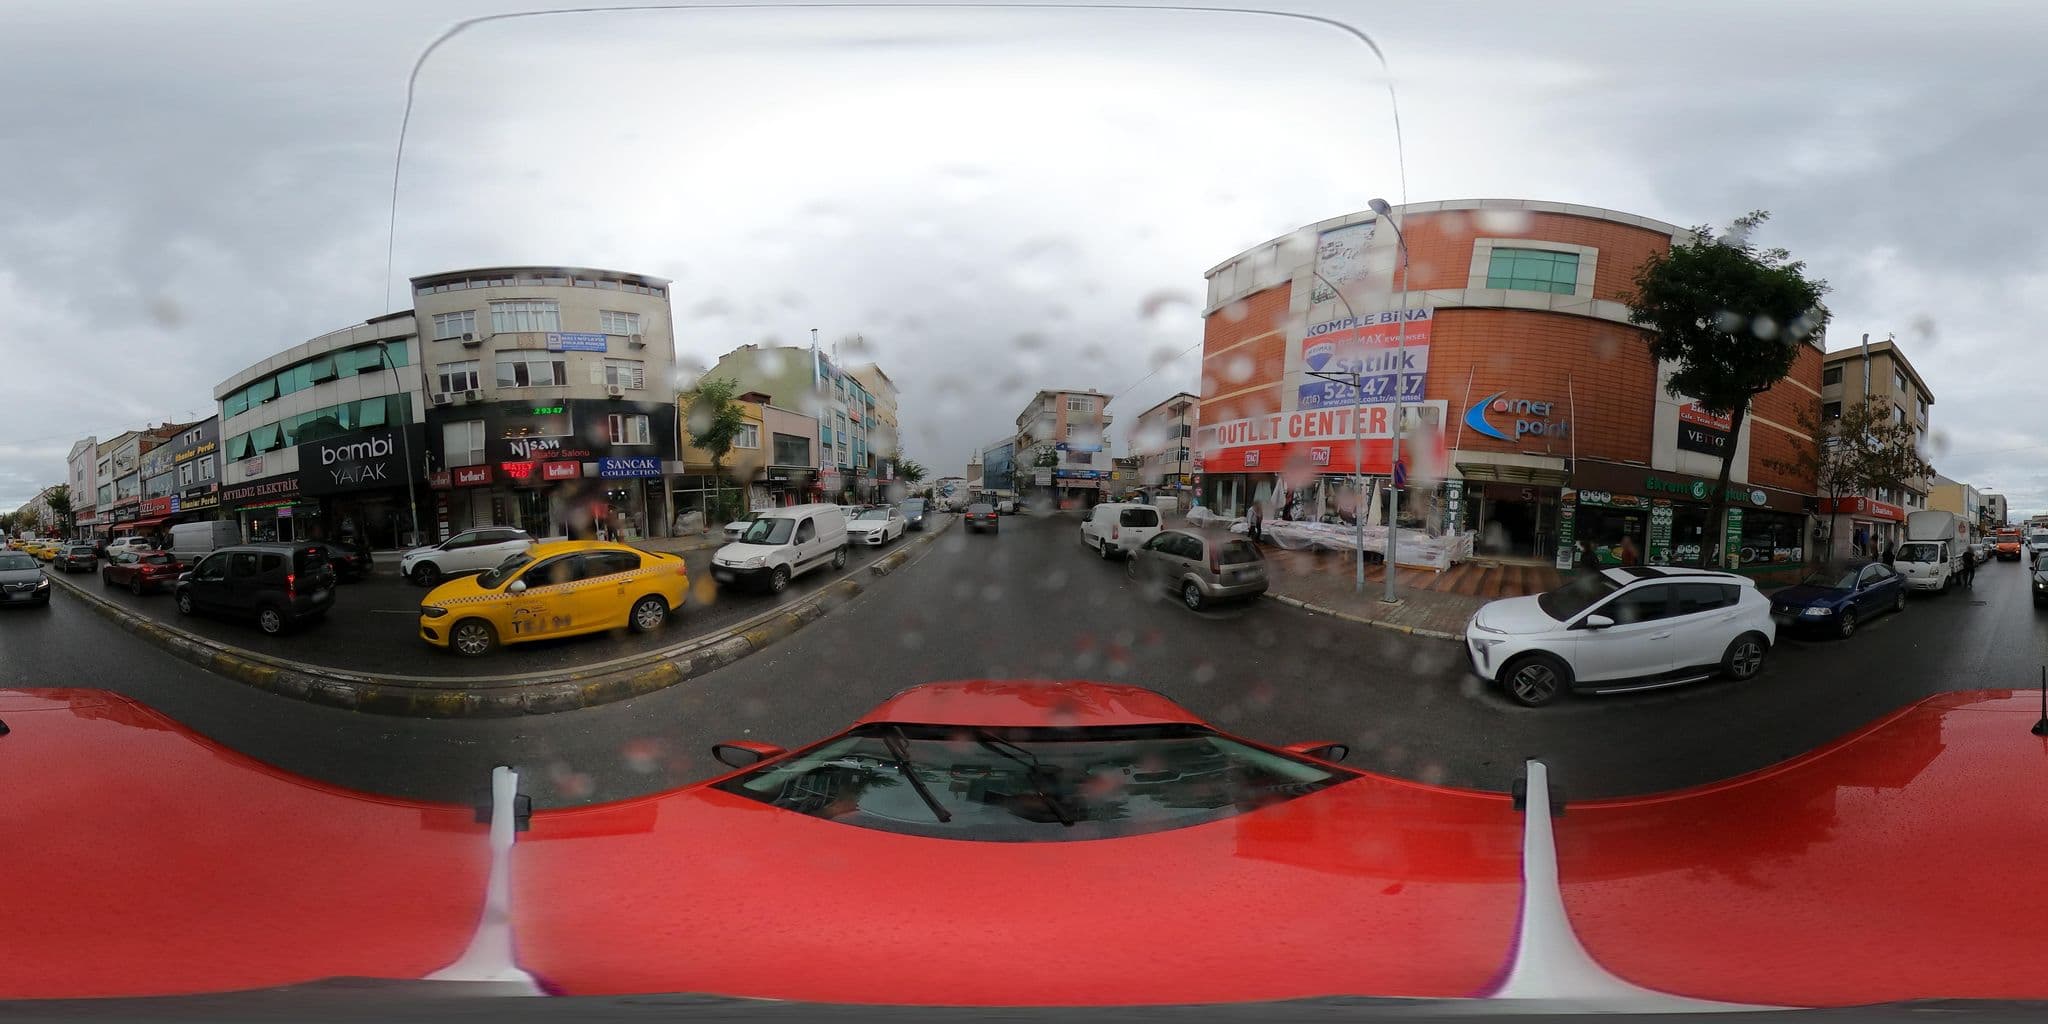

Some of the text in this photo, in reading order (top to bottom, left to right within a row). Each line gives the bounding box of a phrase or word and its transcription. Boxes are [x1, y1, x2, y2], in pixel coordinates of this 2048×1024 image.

[1307, 315, 1375, 337] KOMPLE
[1362, 377, 1390, 396] 47
[1288, 406, 1388, 439] CENTER
[1516, 418, 1568, 440] point
[321, 433, 393, 466] bambi
[330, 462, 387, 485] YATAK
[601, 469, 661, 477] COLLECTION
[606, 459, 656, 470] SANCAK
